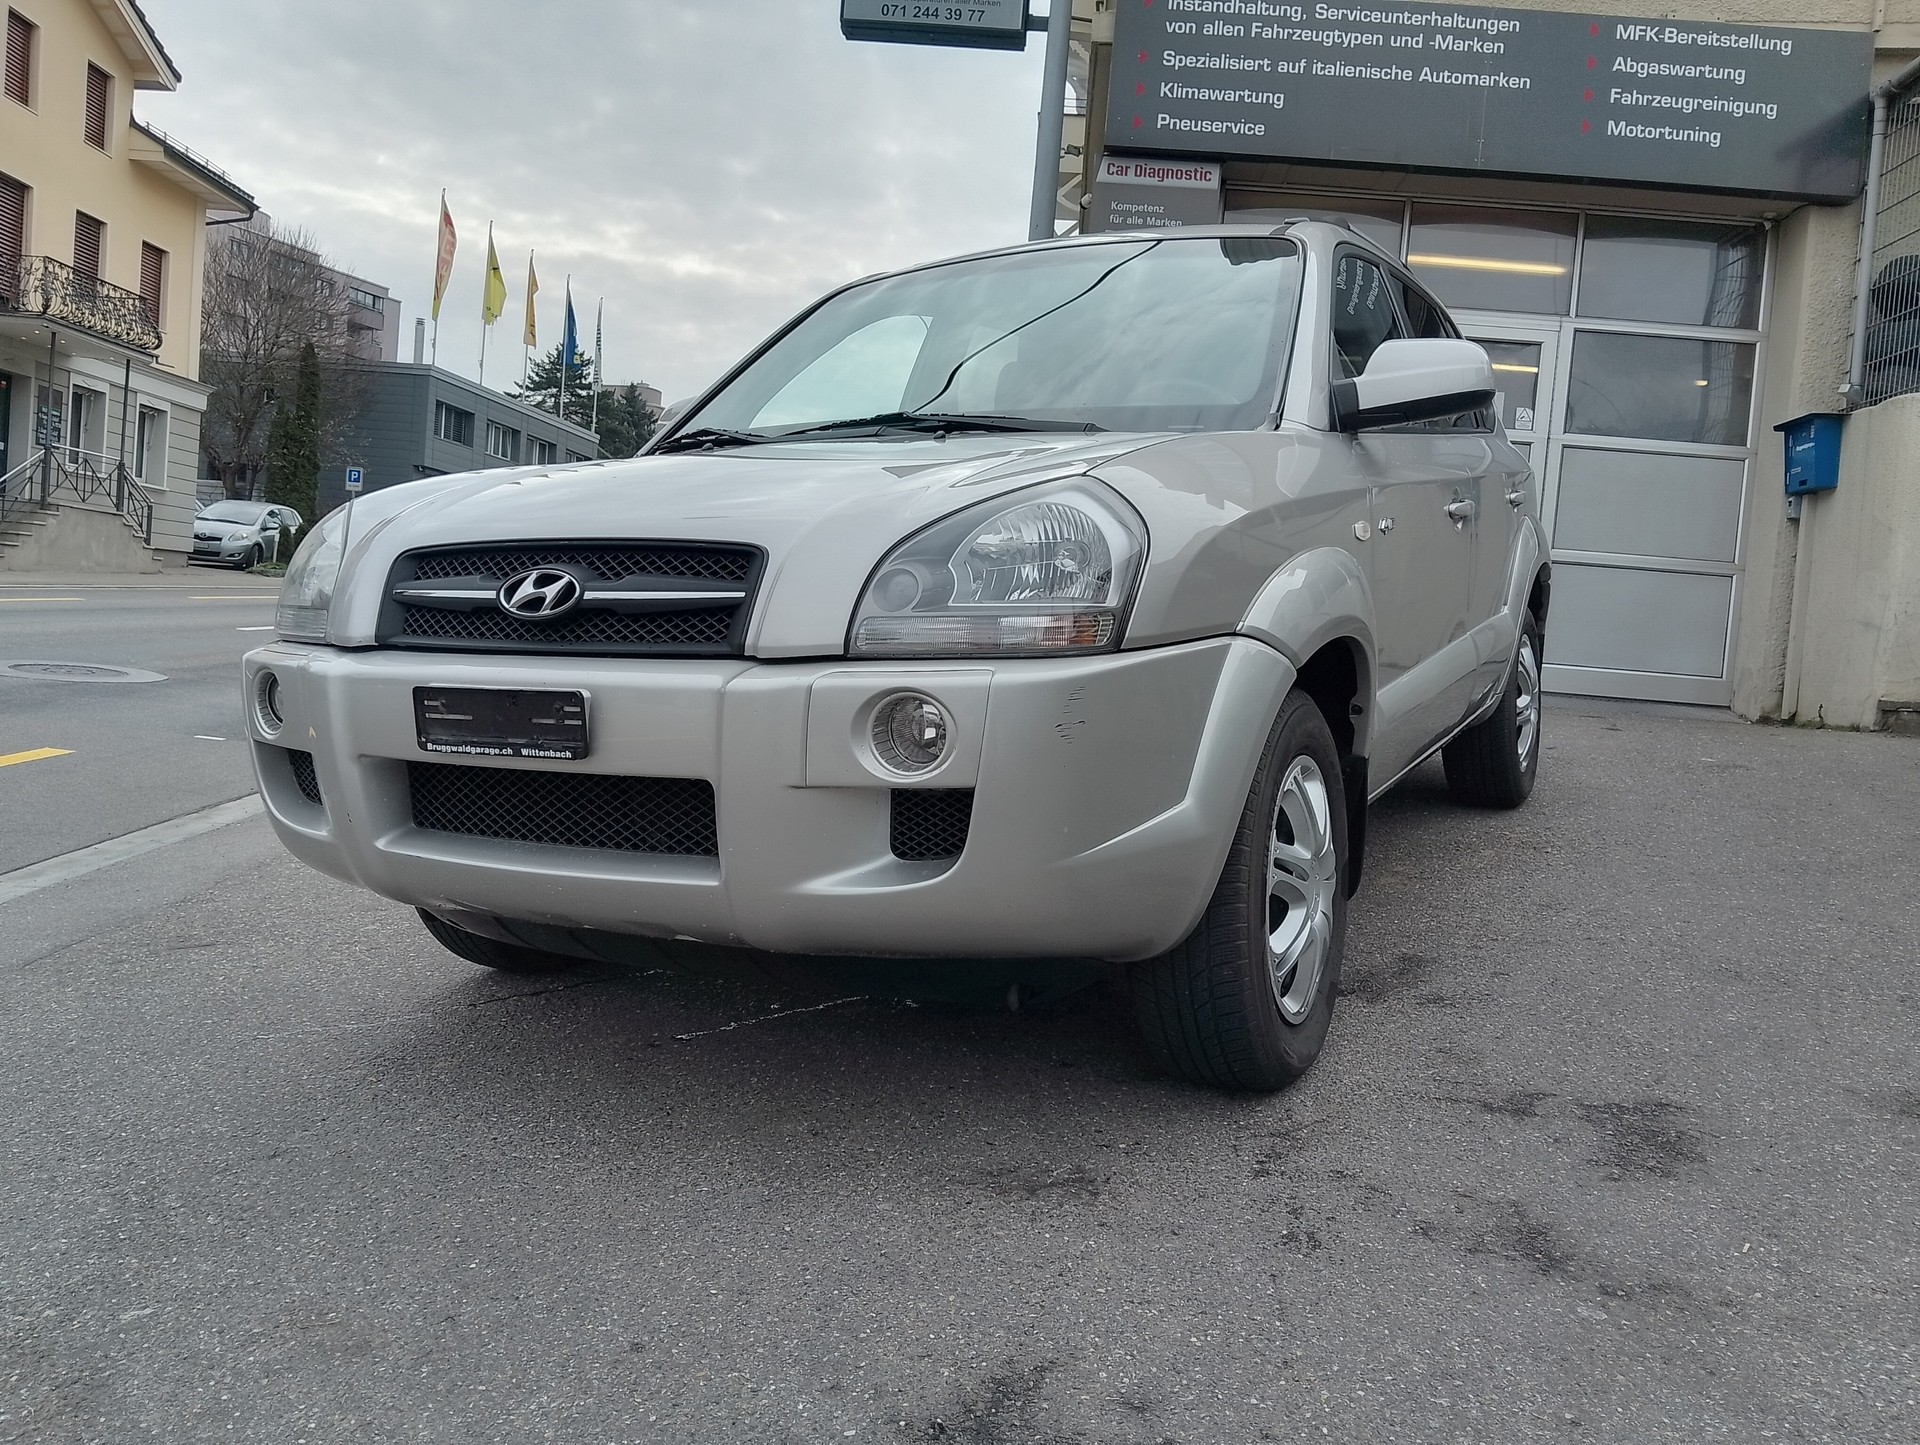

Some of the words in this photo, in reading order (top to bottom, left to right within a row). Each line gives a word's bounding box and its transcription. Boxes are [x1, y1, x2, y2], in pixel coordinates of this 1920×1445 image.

[881, 4, 906, 18] 071
[913, 6, 939, 19] 244
[945, 8, 962, 20] 39
[968, 9, 985, 22] 77
[1167, 0, 1307, 21] Instandhaltung,
[1315, 3, 1520, 34] Serviceunterhaltungen
[1166, 21, 1196, 34] von
[1203, 20, 1244, 37] allen
[1251, 22, 1383, 48] Fahrzeugtypen
[1390, 33, 1424, 49] und
[1429, 34, 1505, 54] -Marken
[1616, 24, 1793, 56] MFK-Bereitstellung
[1162, 50, 1272, 72] Spezialisiert
[1277, 59, 1307, 75] auf
[1312, 59, 1413, 81] italienische
[1418, 66, 1531, 90] Automarken
[1612, 56, 1746, 85] Abgaswartung
[1160, 82, 1285, 109] Klimawartung
[1610, 88, 1778, 120] Fahrzeugreinigung
[1156, 113, 1265, 136] Pneuservice
[1607, 120, 1721, 148] Motortuning
[1106, 162, 1130, 177] Car
[1134, 163, 1213, 183] Diagnostic
[1109, 214, 1124, 224] für
[1126, 216, 1144, 225] alle
[1146, 216, 1183, 227] Marken
[1111, 201, 1165, 213] Kompetenz
[351, 471, 359, 481] P
[427, 742, 513, 756] Bruggwaldgarage.ch
[520, 748, 572, 759] Wittenbach
